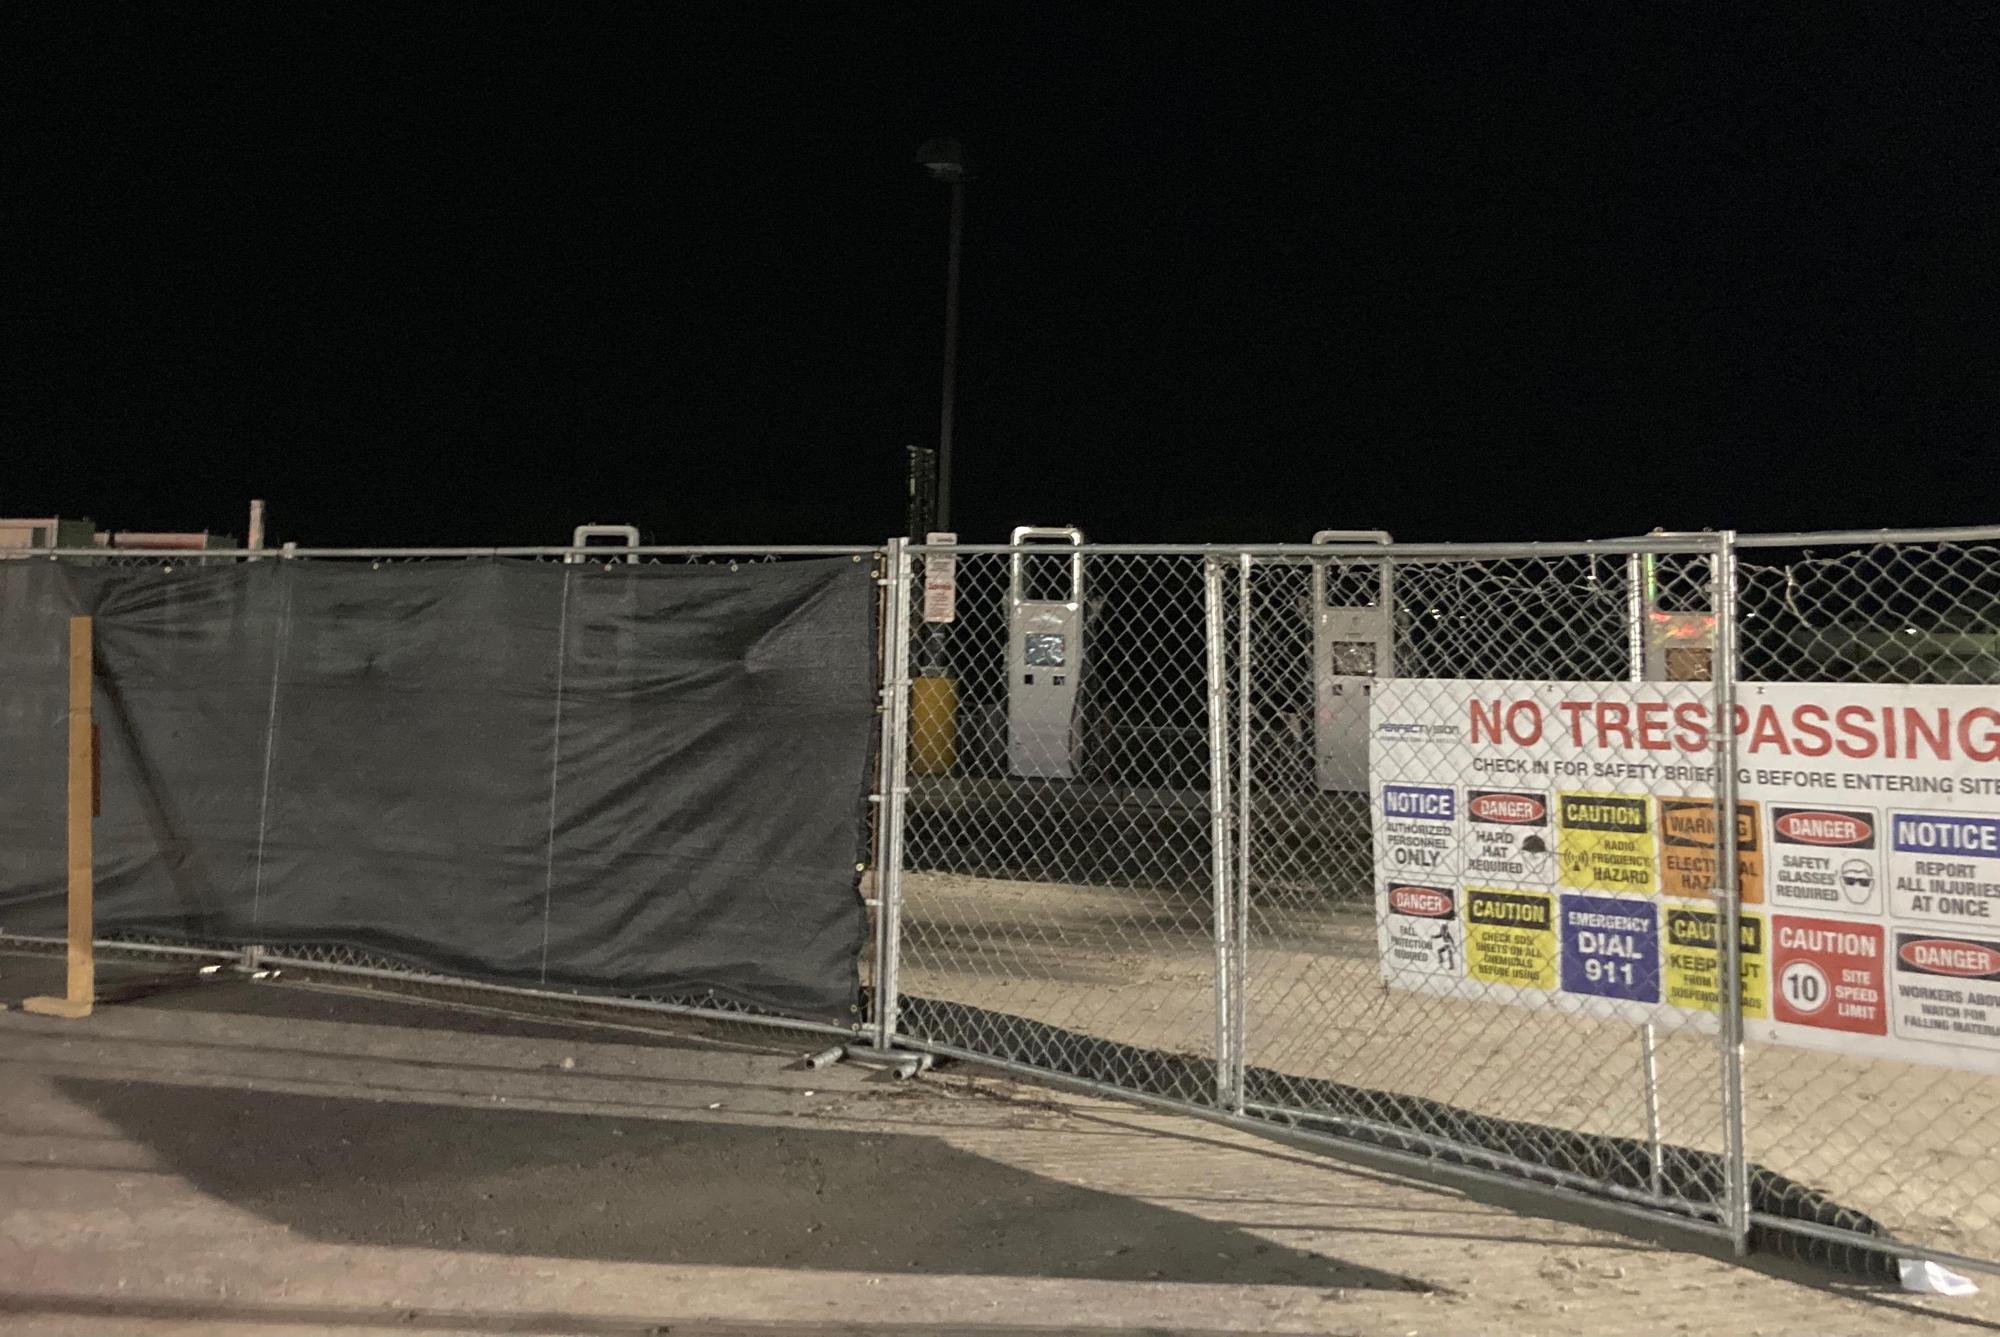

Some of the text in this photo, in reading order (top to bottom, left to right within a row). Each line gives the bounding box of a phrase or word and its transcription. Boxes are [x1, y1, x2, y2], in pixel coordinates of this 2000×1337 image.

[1470, 699, 2000, 762] NO TRESPASSING
[1473, 757, 1528, 774] CHECK
[1533, 763, 1549, 775] IN
[1554, 762, 1588, 776] FOR
[1593, 765, 1659, 780] SAFETY
[1664, 767, 1751, 784] BRIEFIG
[1757, 769, 1837, 788] BEFORE
[1843, 774, 1953, 793] ENTERING
[1386, 791, 1450, 815] NOTICE
[1480, 800, 1535, 818] DANGER
[1566, 803, 1641, 825] CAUTION
[1387, 823, 1452, 837] AUTHORIZED
[1670, 816, 1748, 836] WARNG
[1788, 817, 1857, 839] DANGER
[1387, 834, 1449, 849] PERSONNEL
[1476, 830, 1515, 844] HARD
[1899, 821, 1998, 851] NOTICE
[1482, 845, 1509, 858] HAT
[1604, 840, 1635, 851] RADIO
[1395, 847, 1441, 867] ONLY
[1592, 853, 1650, 867] FREQUENCY
[1666, 855, 1759, 877] ELECTAL
[1782, 855, 1830, 870] SAFETY
[1468, 859, 1524, 875] REQUIRED
[1593, 867, 1649, 884] HAZARD
[1915, 861, 1976, 878] REPORT
[1778, 869, 1836, 885] GLASSES
[1776, 885, 1839, 901] REQUIRED
[1897, 877, 2000, 898] ALL INJURIES
[1396, 892, 1443, 912] DANGER
[1472, 899, 1545, 923] CAUTION
[1911, 895, 1990, 917] AT ONCE
[1568, 911, 1649, 932] EMERGENCY
[1481, 931, 1511, 943] CHECK
[1674, 919, 1755, 945] CAUTN
[1578, 930, 1643, 959] DIAL
[1779, 926, 1876, 957] CAUTION
[1525, 947, 1543, 958] ALL
[1914, 945, 1990, 970] DANGER
[1585, 958, 1634, 985] 911
[1670, 954, 1717, 971] KEEP
[1684, 974, 1712, 988] FROM
[1841, 968, 1871, 984] SITE
[1788, 975, 1819, 1002] 10
[1835, 986, 1878, 1003] SPEED
[1898, 984, 1964, 1003] WORKERS
[1838, 1003, 1877, 1020] LIMIT
[1922, 1004, 1986, 1021] WATCH FOR
[1904, 1015, 1949, 1030] FALLING
